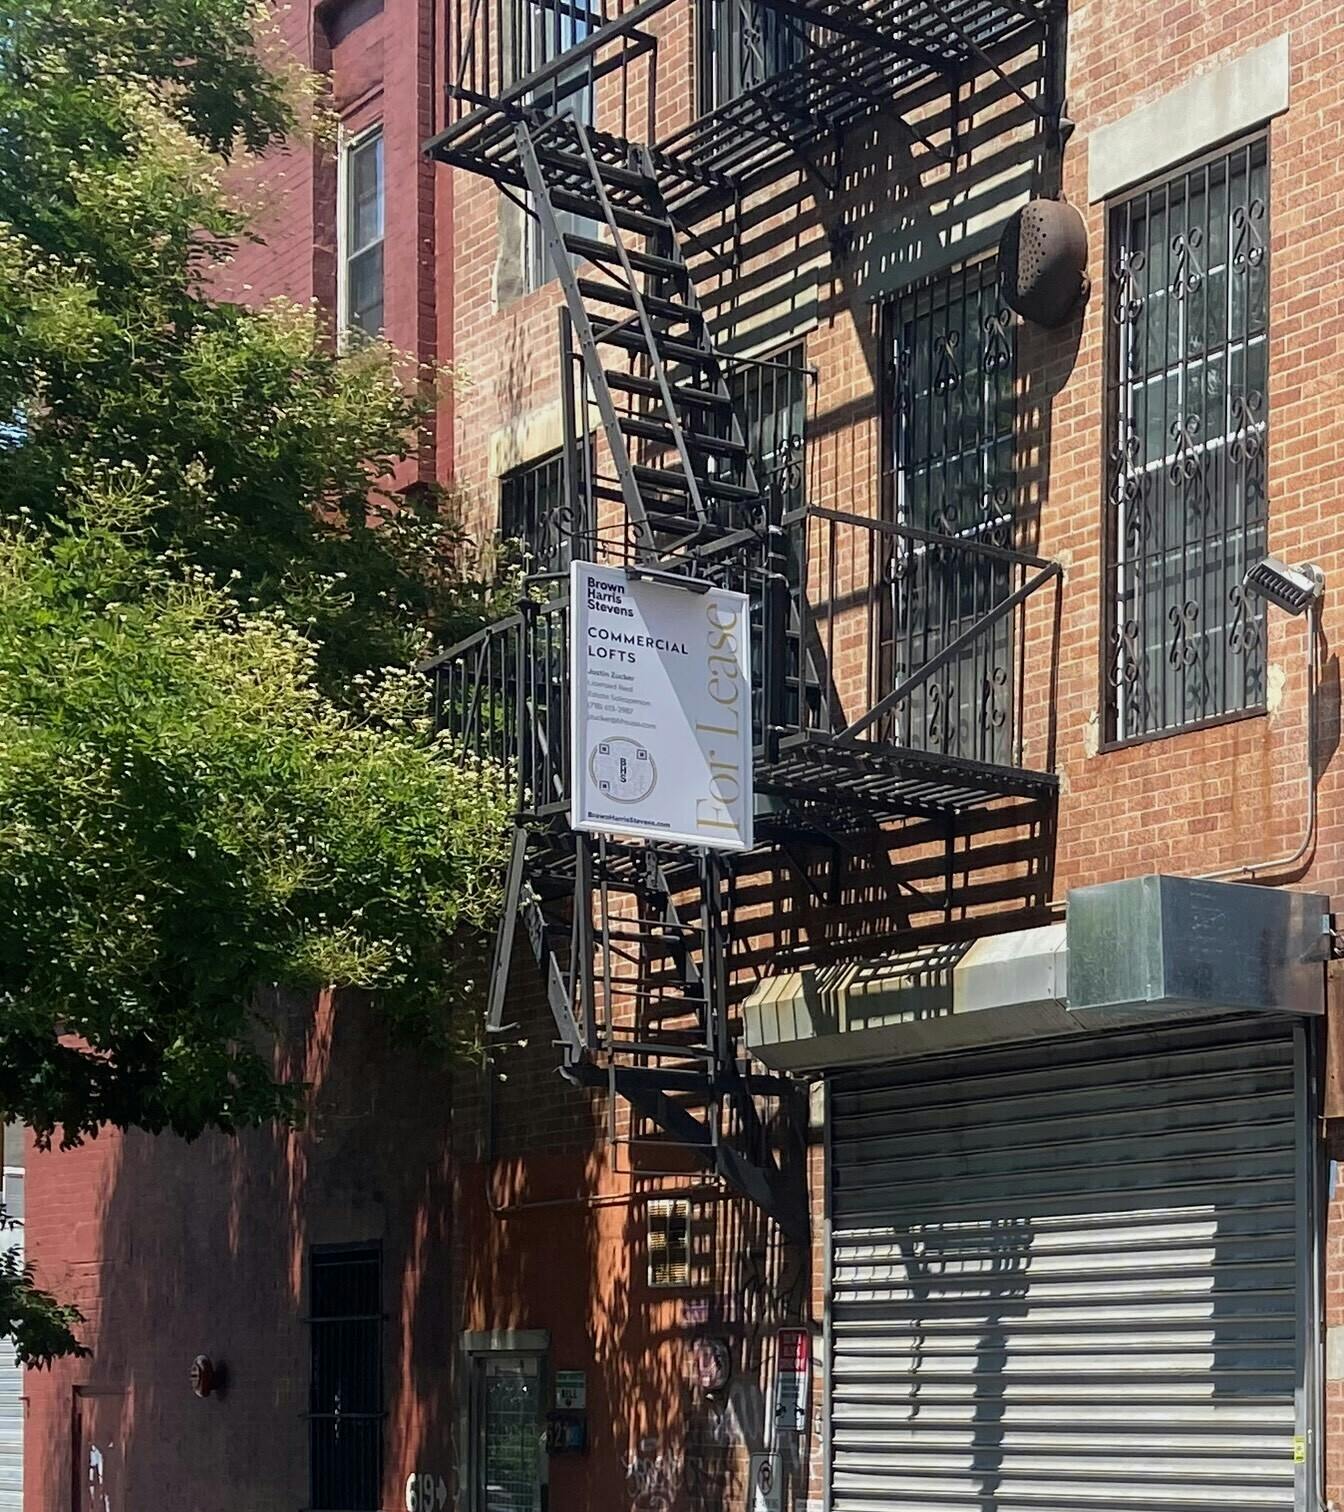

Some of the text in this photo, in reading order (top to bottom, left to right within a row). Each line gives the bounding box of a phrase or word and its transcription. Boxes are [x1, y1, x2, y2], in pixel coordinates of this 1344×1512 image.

[588, 577, 625, 594] Brown
[588, 588, 622, 604] Harris
[588, 599, 634, 617] Stevens
[588, 627, 688, 655] COMMERCIAL
[588, 645, 636, 663] LOFTS
[695, 602, 740, 832] For Lease
[619, 757, 627, 783] BHS
[588, 811, 671, 828] BrownHarrisStevens.com
